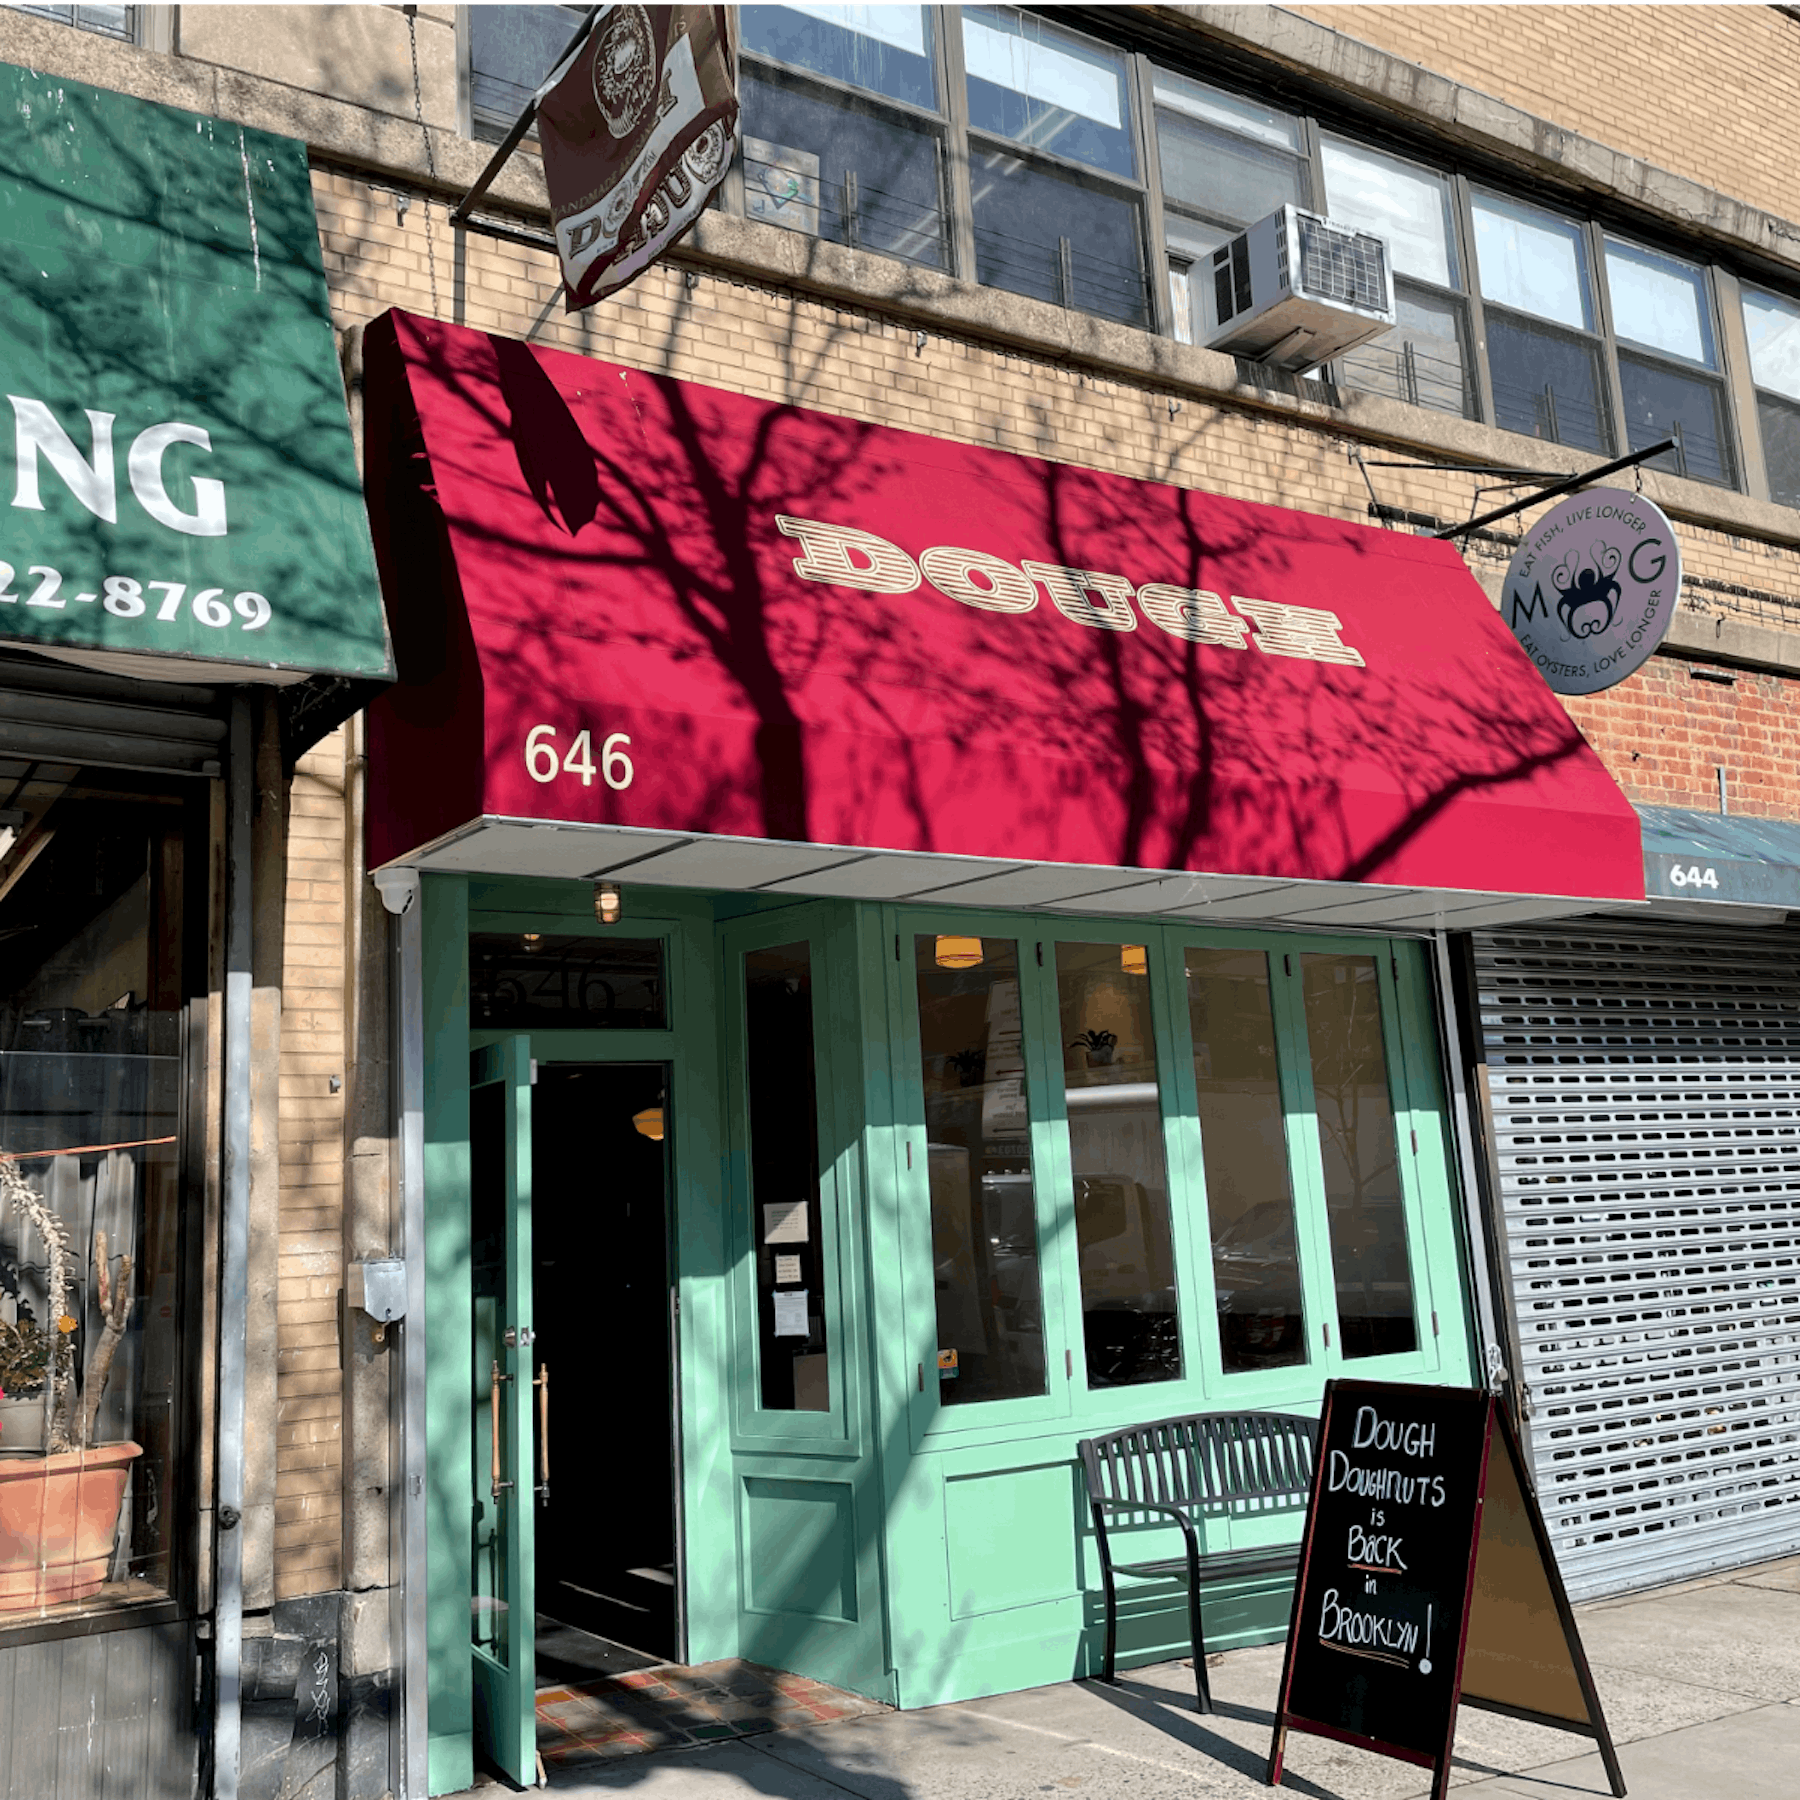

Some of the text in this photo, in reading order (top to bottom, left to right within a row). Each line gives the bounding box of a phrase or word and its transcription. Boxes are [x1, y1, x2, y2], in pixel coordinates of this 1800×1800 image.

[6, 394, 228, 536] NG
[1519, 505, 1647, 578] EAT FISH, LIVE LONGER
[775, 513, 1366, 667] DOUGH
[1520, 588, 1663, 678] EAT OYSTERS, LOVE LONGER
[525, 724, 634, 790] 646
[1670, 864, 1719, 889] 644
[1352, 1405, 1435, 1458] DOUGH
[1370, 1507, 1385, 1526] is
[1365, 1574, 1377, 1595] in
